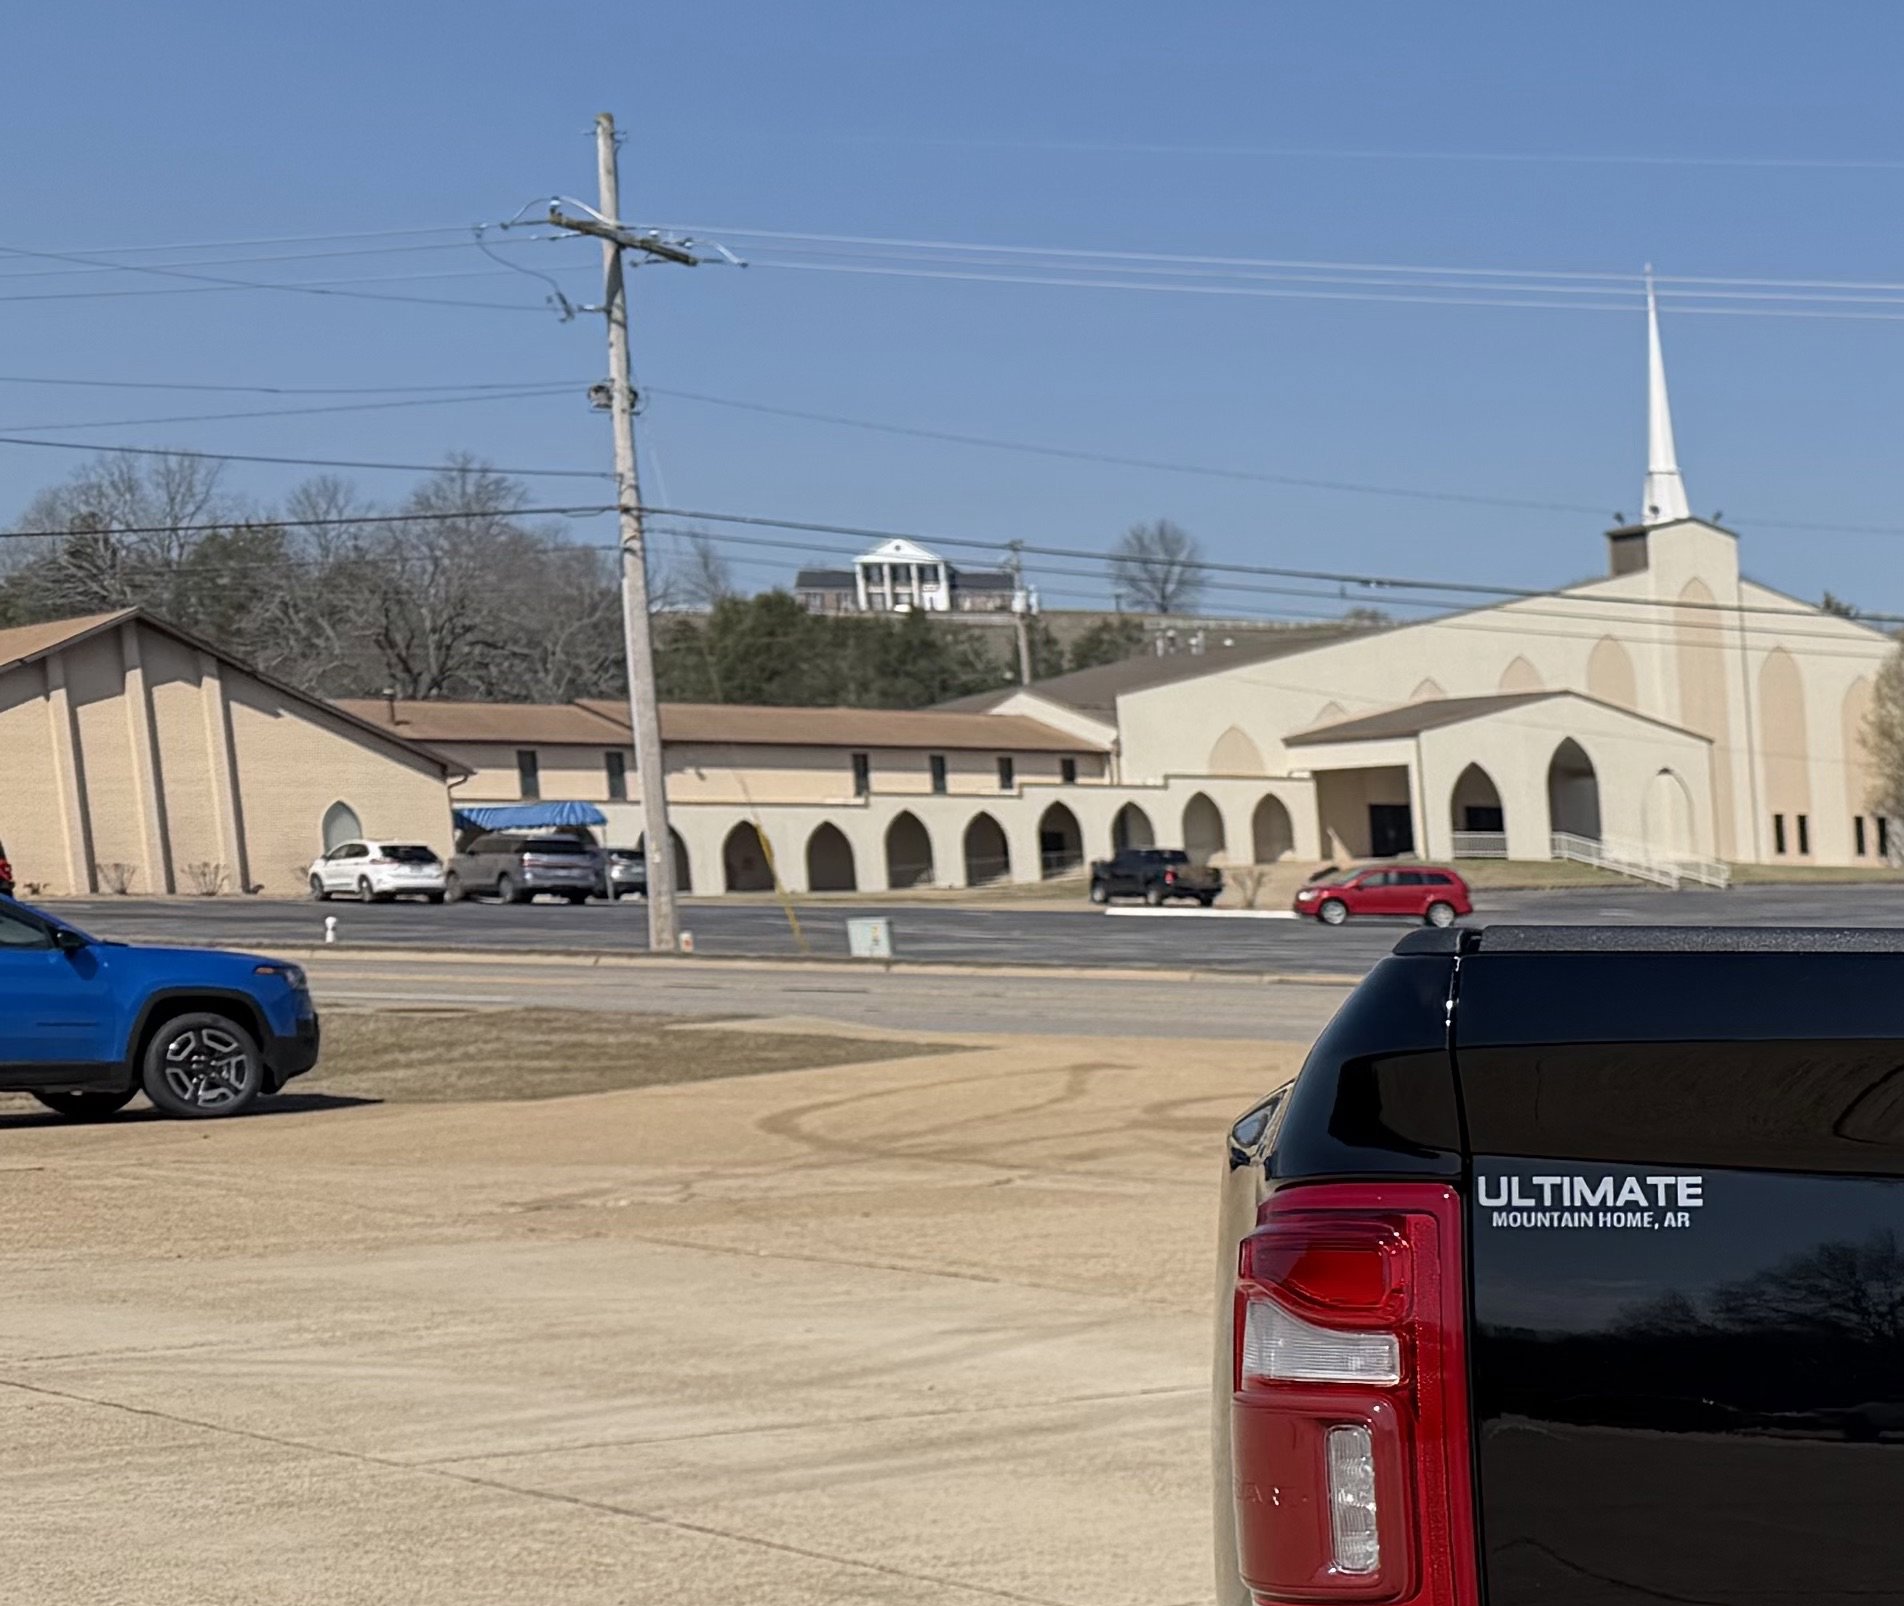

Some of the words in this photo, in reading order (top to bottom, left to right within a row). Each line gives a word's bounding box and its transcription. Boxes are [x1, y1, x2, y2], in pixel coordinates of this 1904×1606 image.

[1477, 1175, 1704, 1207] ULTIMATE
[1491, 1210, 1594, 1229] MOUNTAIN
[1598, 1210, 1659, 1230] HOME,
[1663, 1210, 1691, 1229] AR
